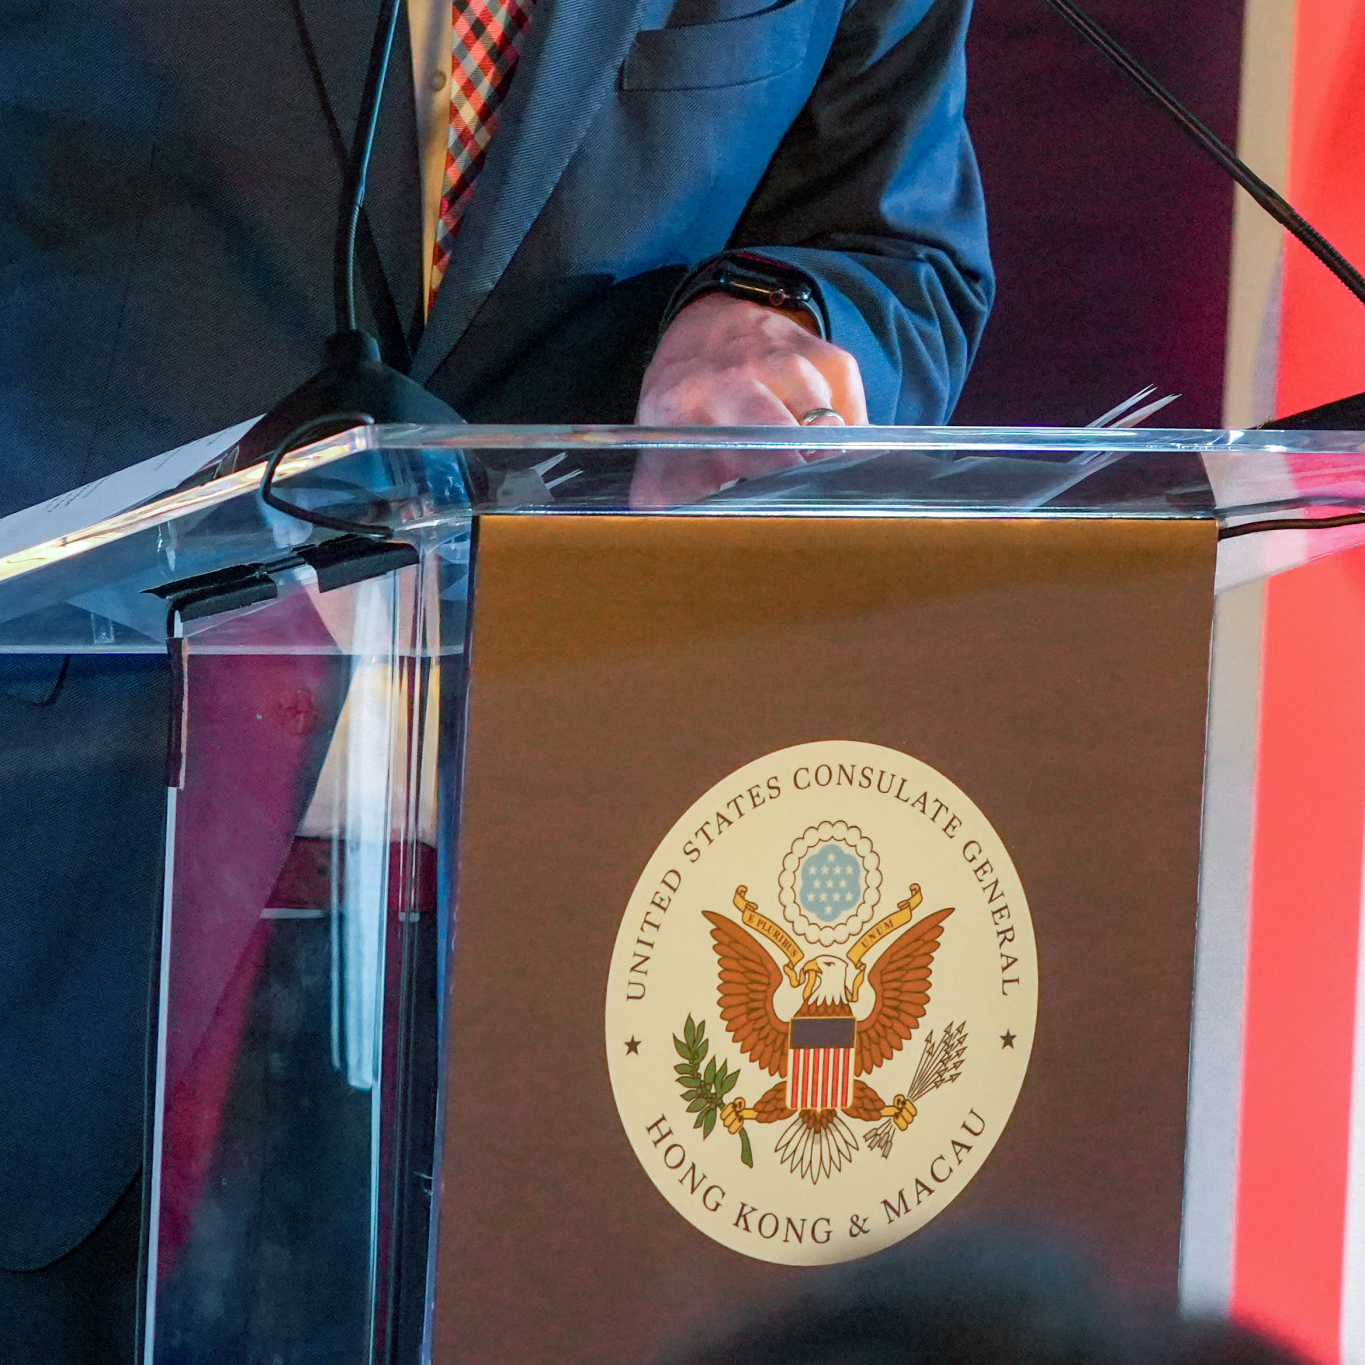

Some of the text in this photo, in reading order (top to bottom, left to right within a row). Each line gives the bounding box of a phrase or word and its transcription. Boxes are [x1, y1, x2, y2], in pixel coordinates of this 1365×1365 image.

[626, 763, 1021, 1002] UNITED STATES CONSULATE GENERAL
[747, 914, 895, 958] E PLURIBUS UNUM
[644, 1107, 987, 1245] HONG KONG & MACAU
